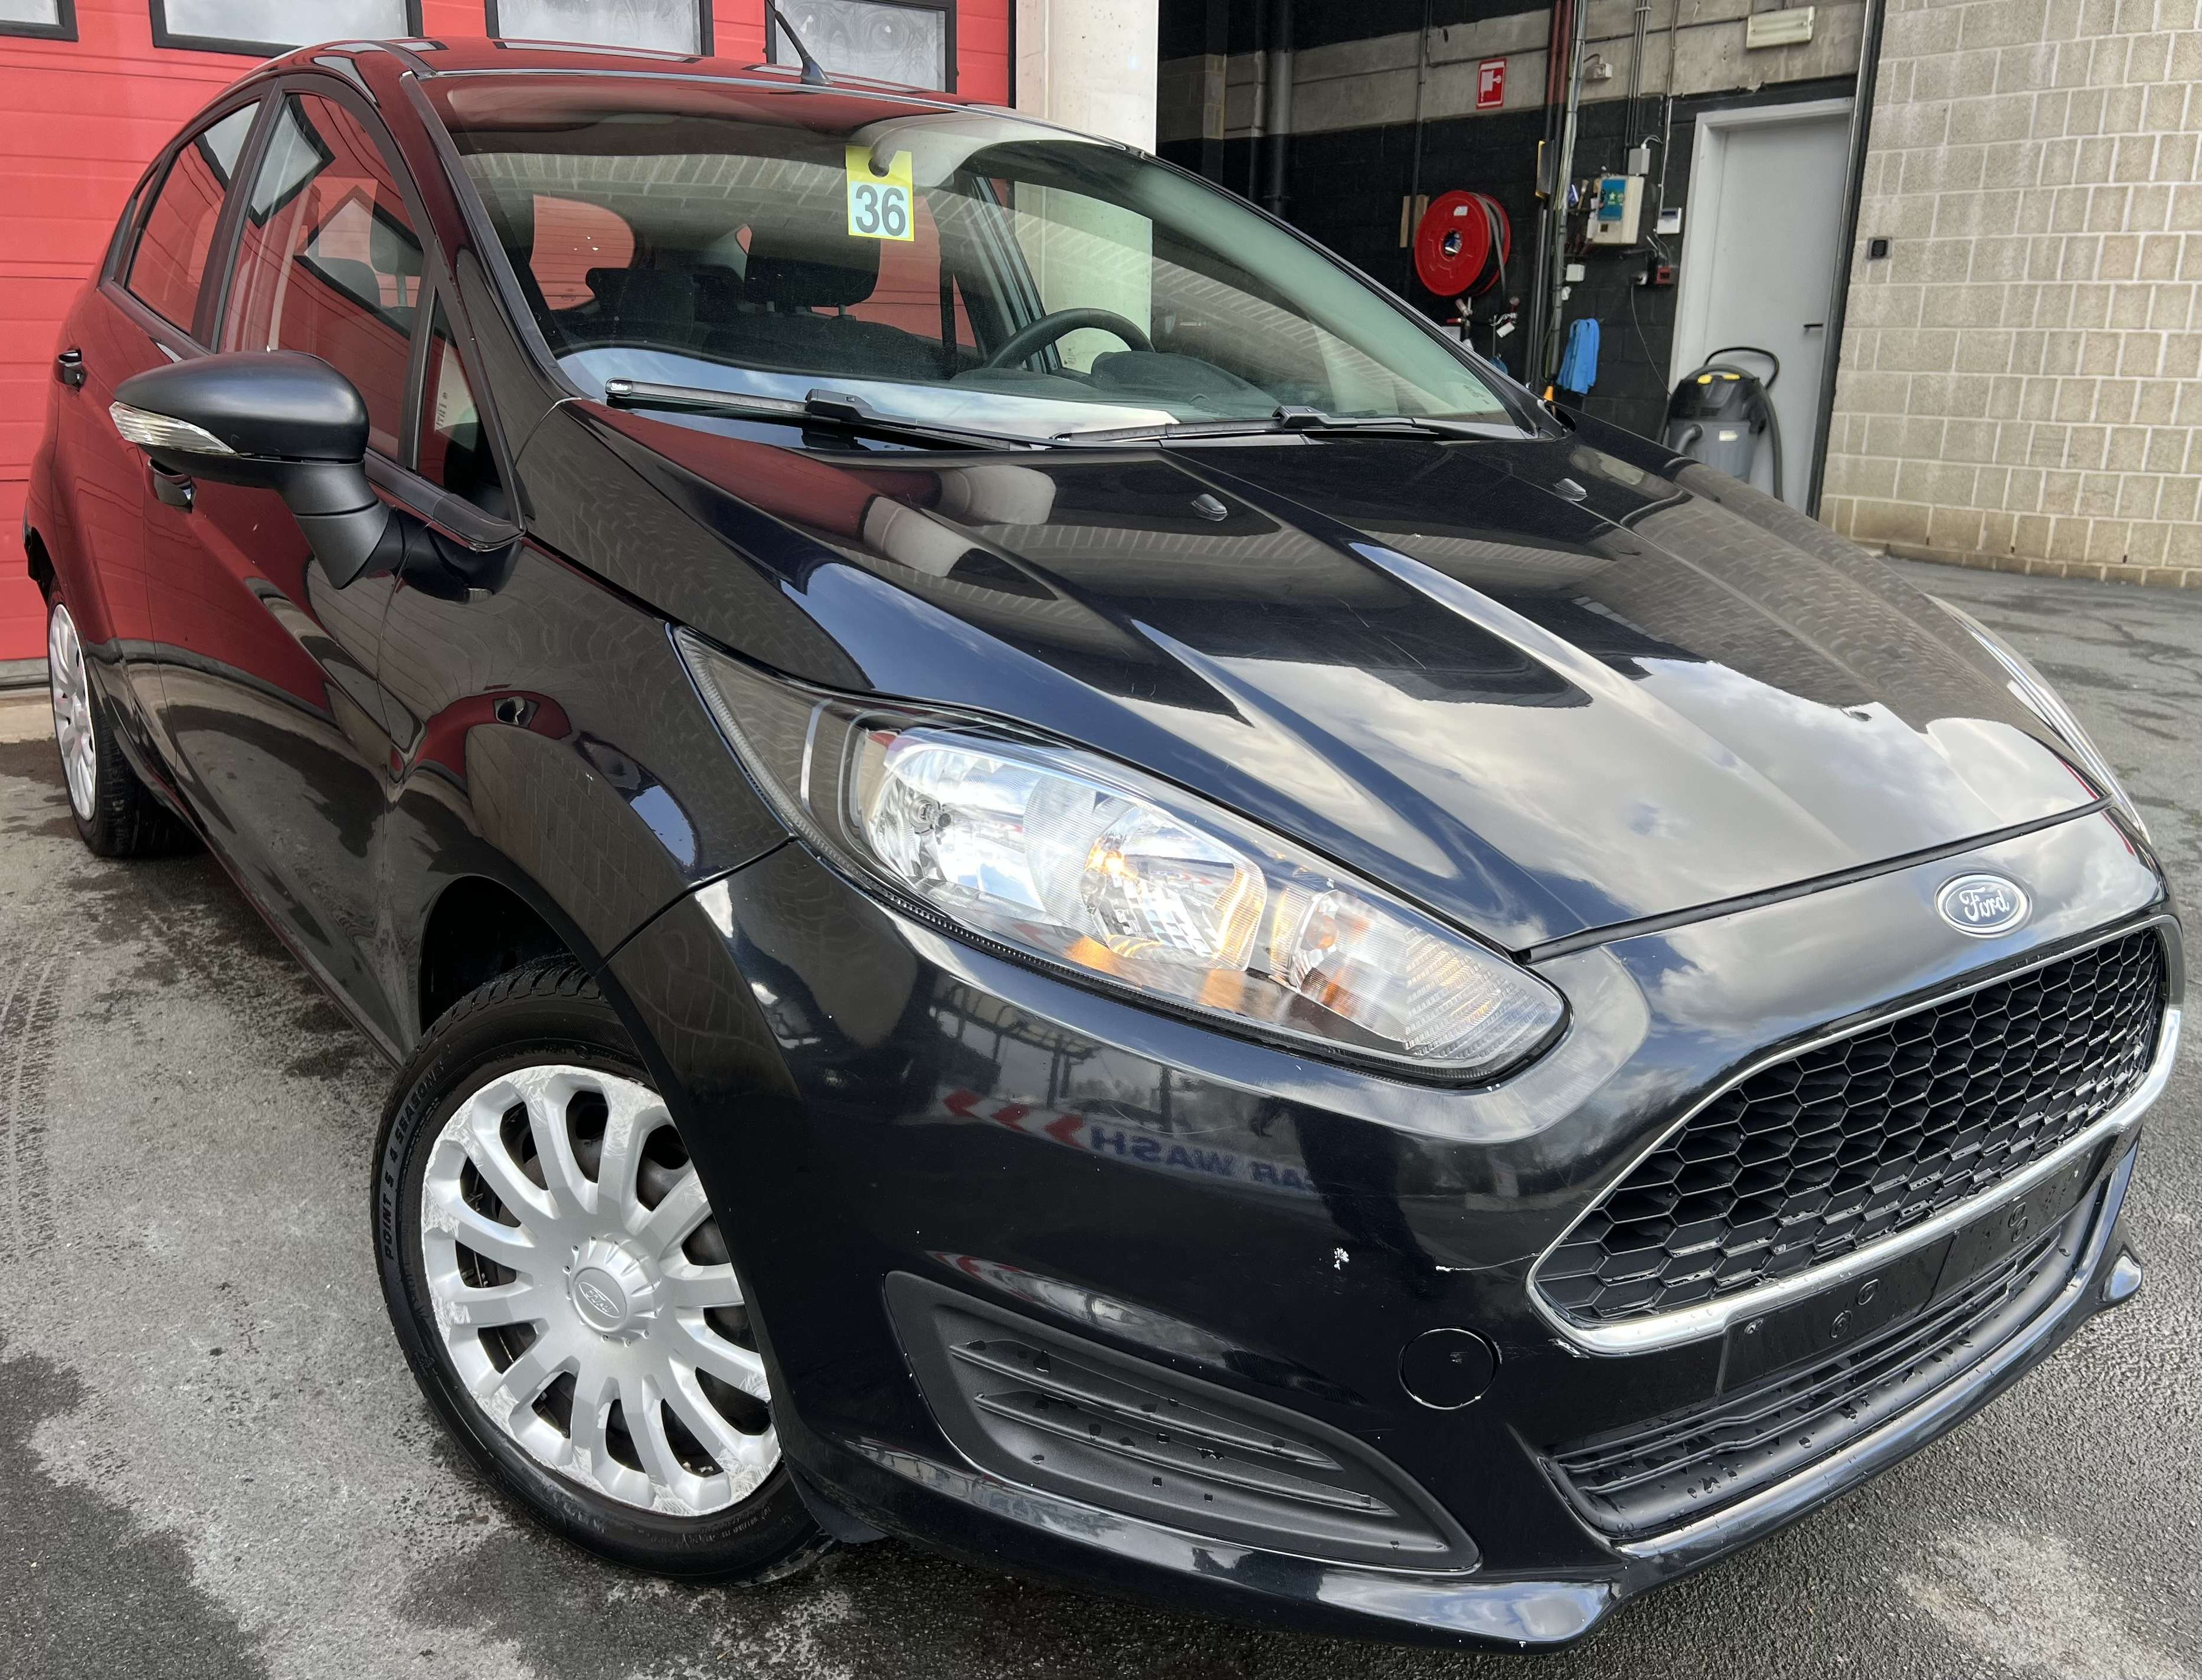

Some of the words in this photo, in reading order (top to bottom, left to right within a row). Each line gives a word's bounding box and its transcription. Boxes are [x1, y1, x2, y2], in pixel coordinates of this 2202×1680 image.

[855, 184, 906, 237] 36
[1958, 886, 2010, 922] Ford
[390, 1146, 398, 1163] 4
[384, 1170, 394, 1188] S
[382, 1193, 394, 1260] POINT
